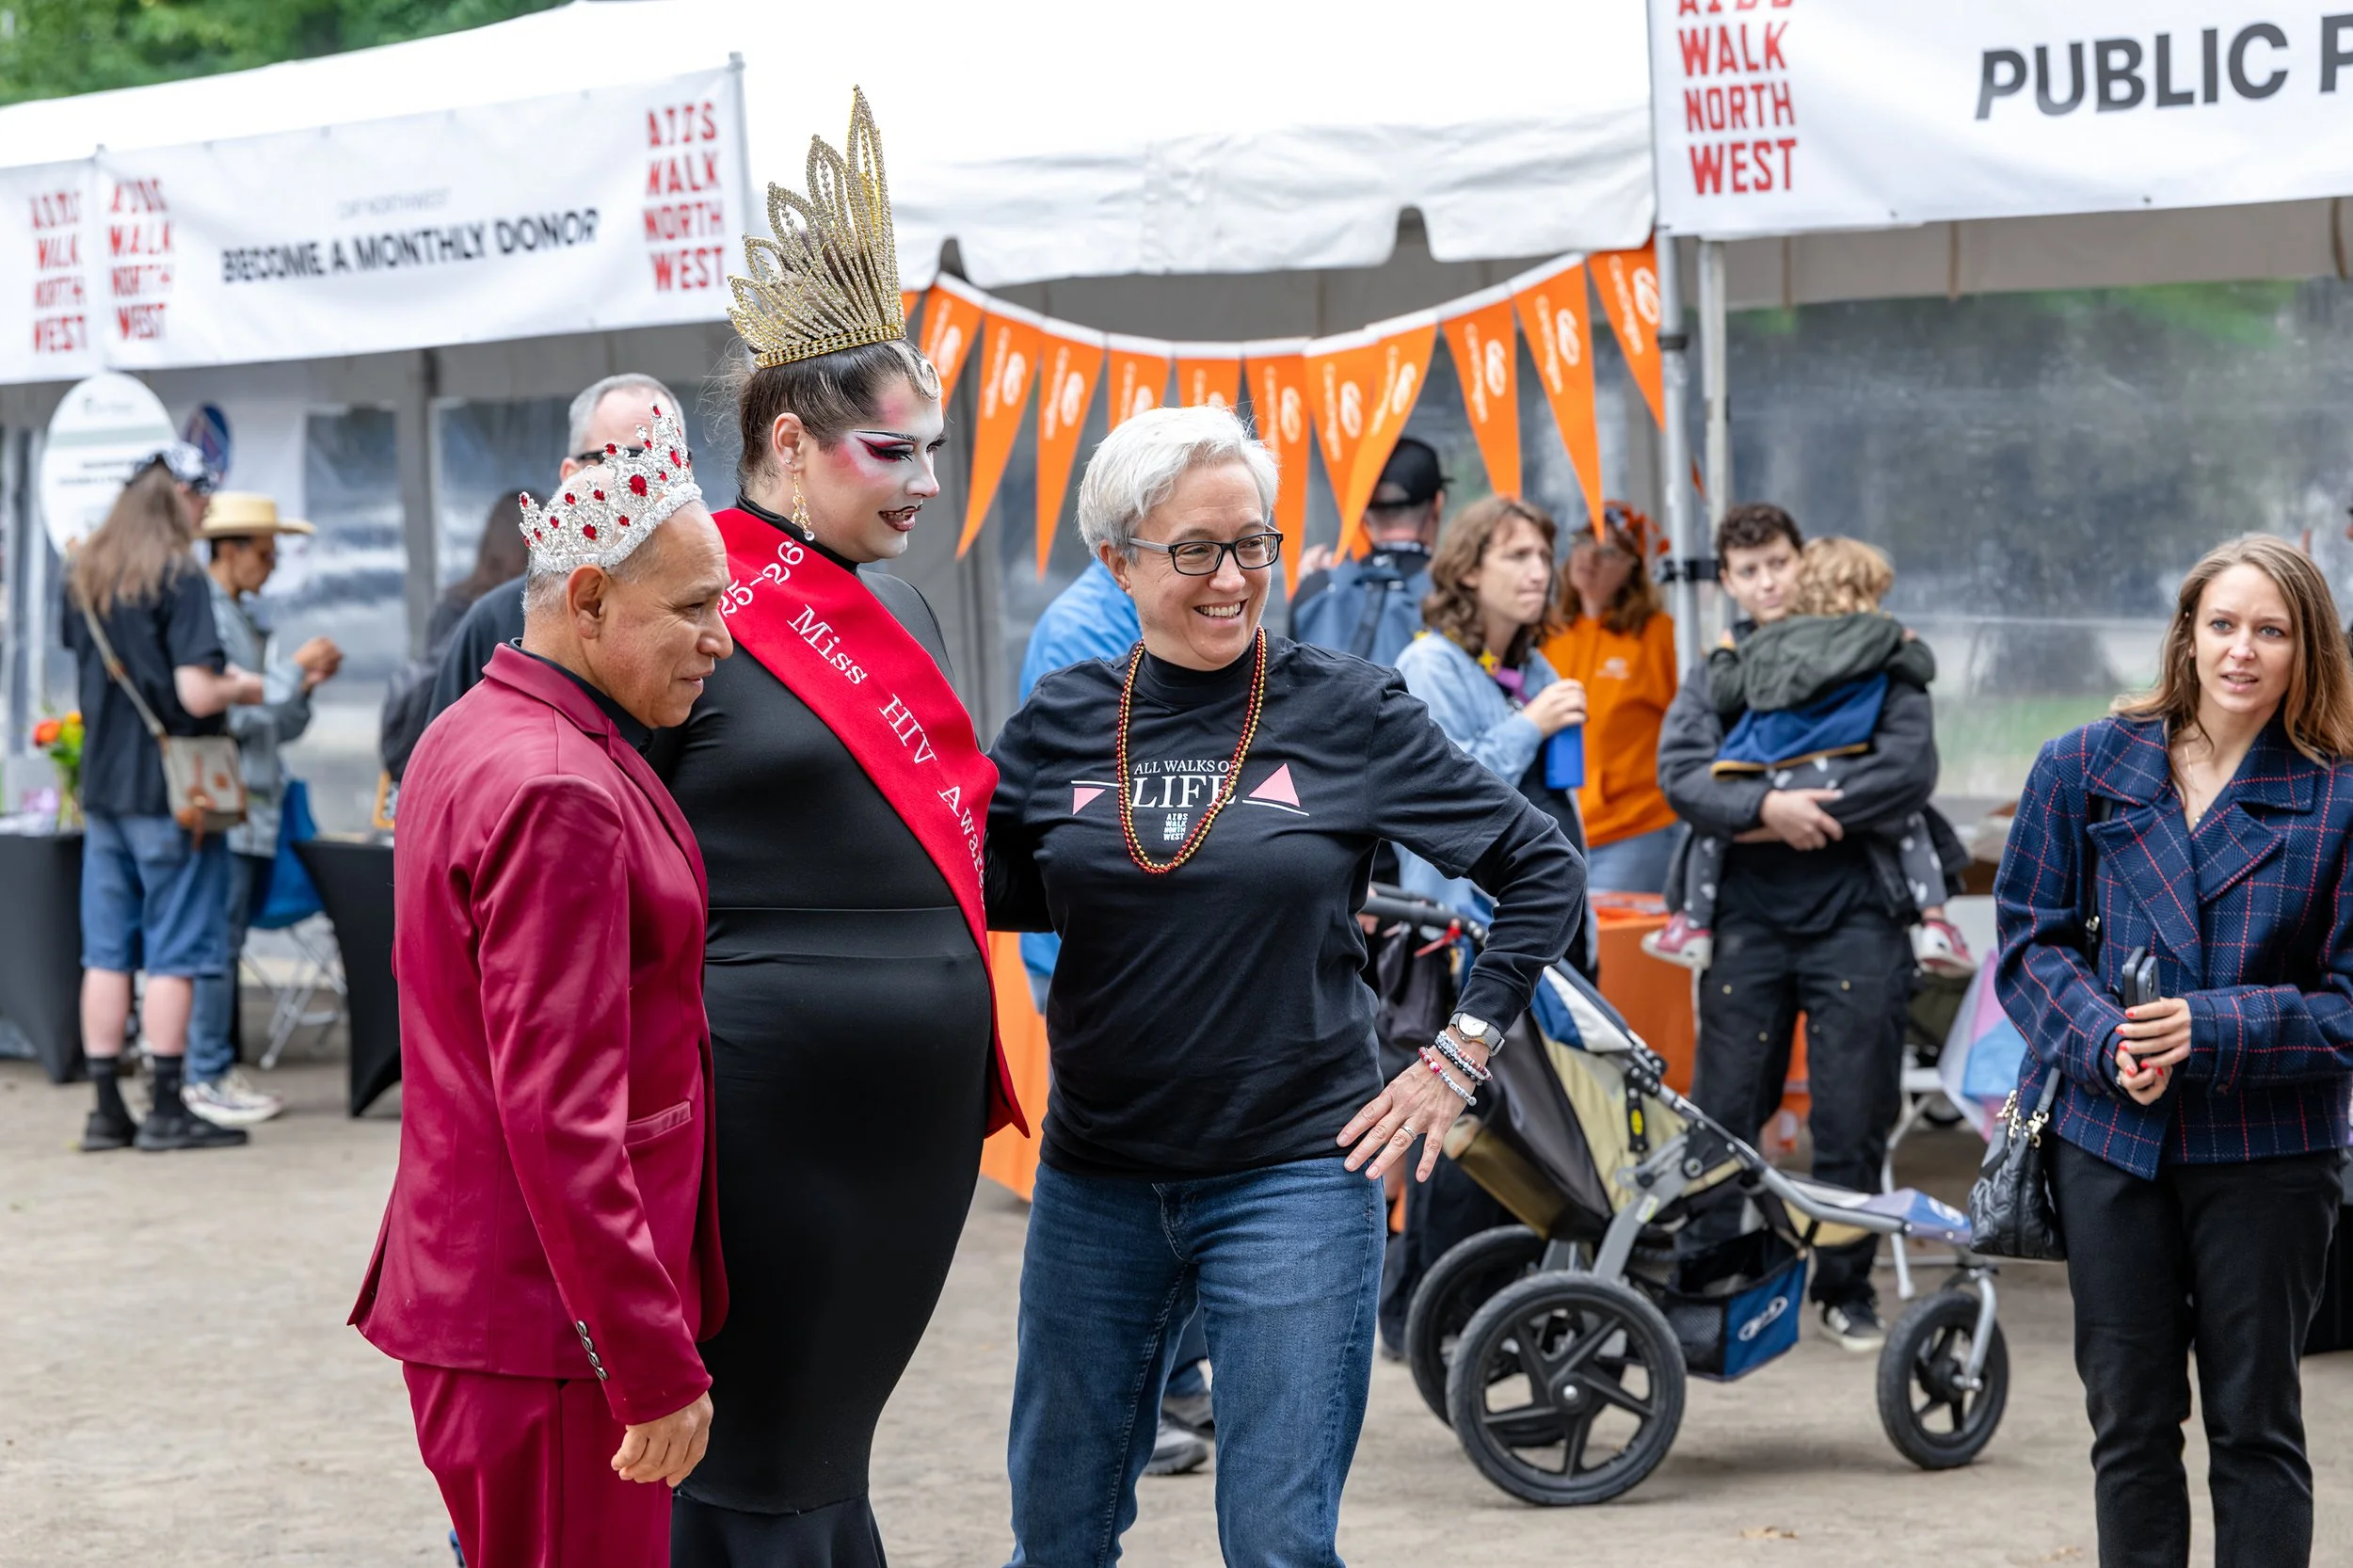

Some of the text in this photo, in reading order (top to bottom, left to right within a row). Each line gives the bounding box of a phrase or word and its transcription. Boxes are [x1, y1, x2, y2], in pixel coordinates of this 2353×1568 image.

[1678, 21, 1788, 77] WALK
[1975, 22, 2289, 120] PUBLIC
[1685, 81, 1795, 132] NORTH
[647, 151, 720, 197] WALK
[1689, 138, 1797, 195] WEST
[221, 207, 600, 283] BECOME A MONTHLY DONOR
[643, 201, 724, 241] NORTH
[650, 247, 723, 291] WEST
[717, 540, 984, 910] 25-26 Miss HIV Aware
[1131, 775, 1237, 808] LIFE
[1133, 760, 1237, 775] ALL WALKS O
[1166, 812, 1188, 821] AIDS
